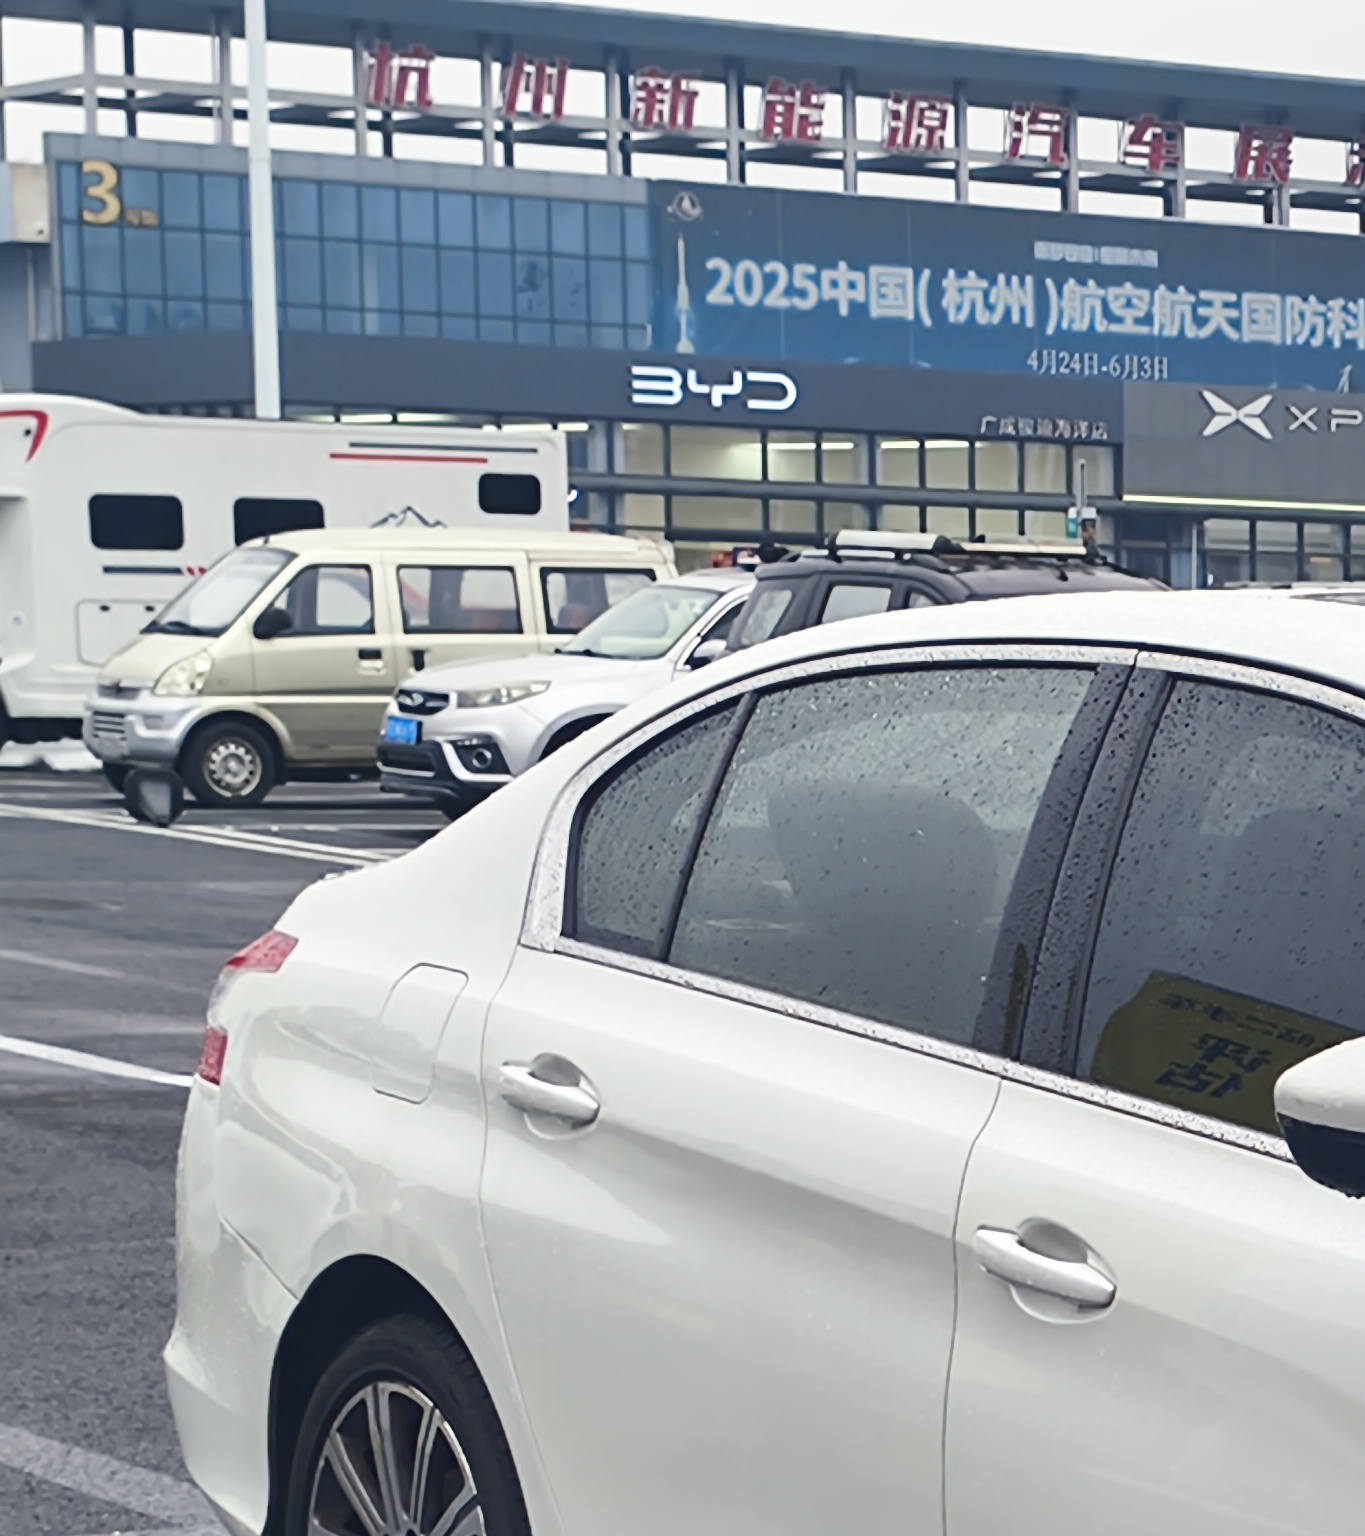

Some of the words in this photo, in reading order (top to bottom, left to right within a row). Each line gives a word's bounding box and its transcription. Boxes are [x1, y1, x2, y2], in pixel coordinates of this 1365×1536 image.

[82, 160, 121, 225] 3
[1026, 348, 1169, 381] 4月24日-6月3日
[631, 365, 798, 411] BYD
